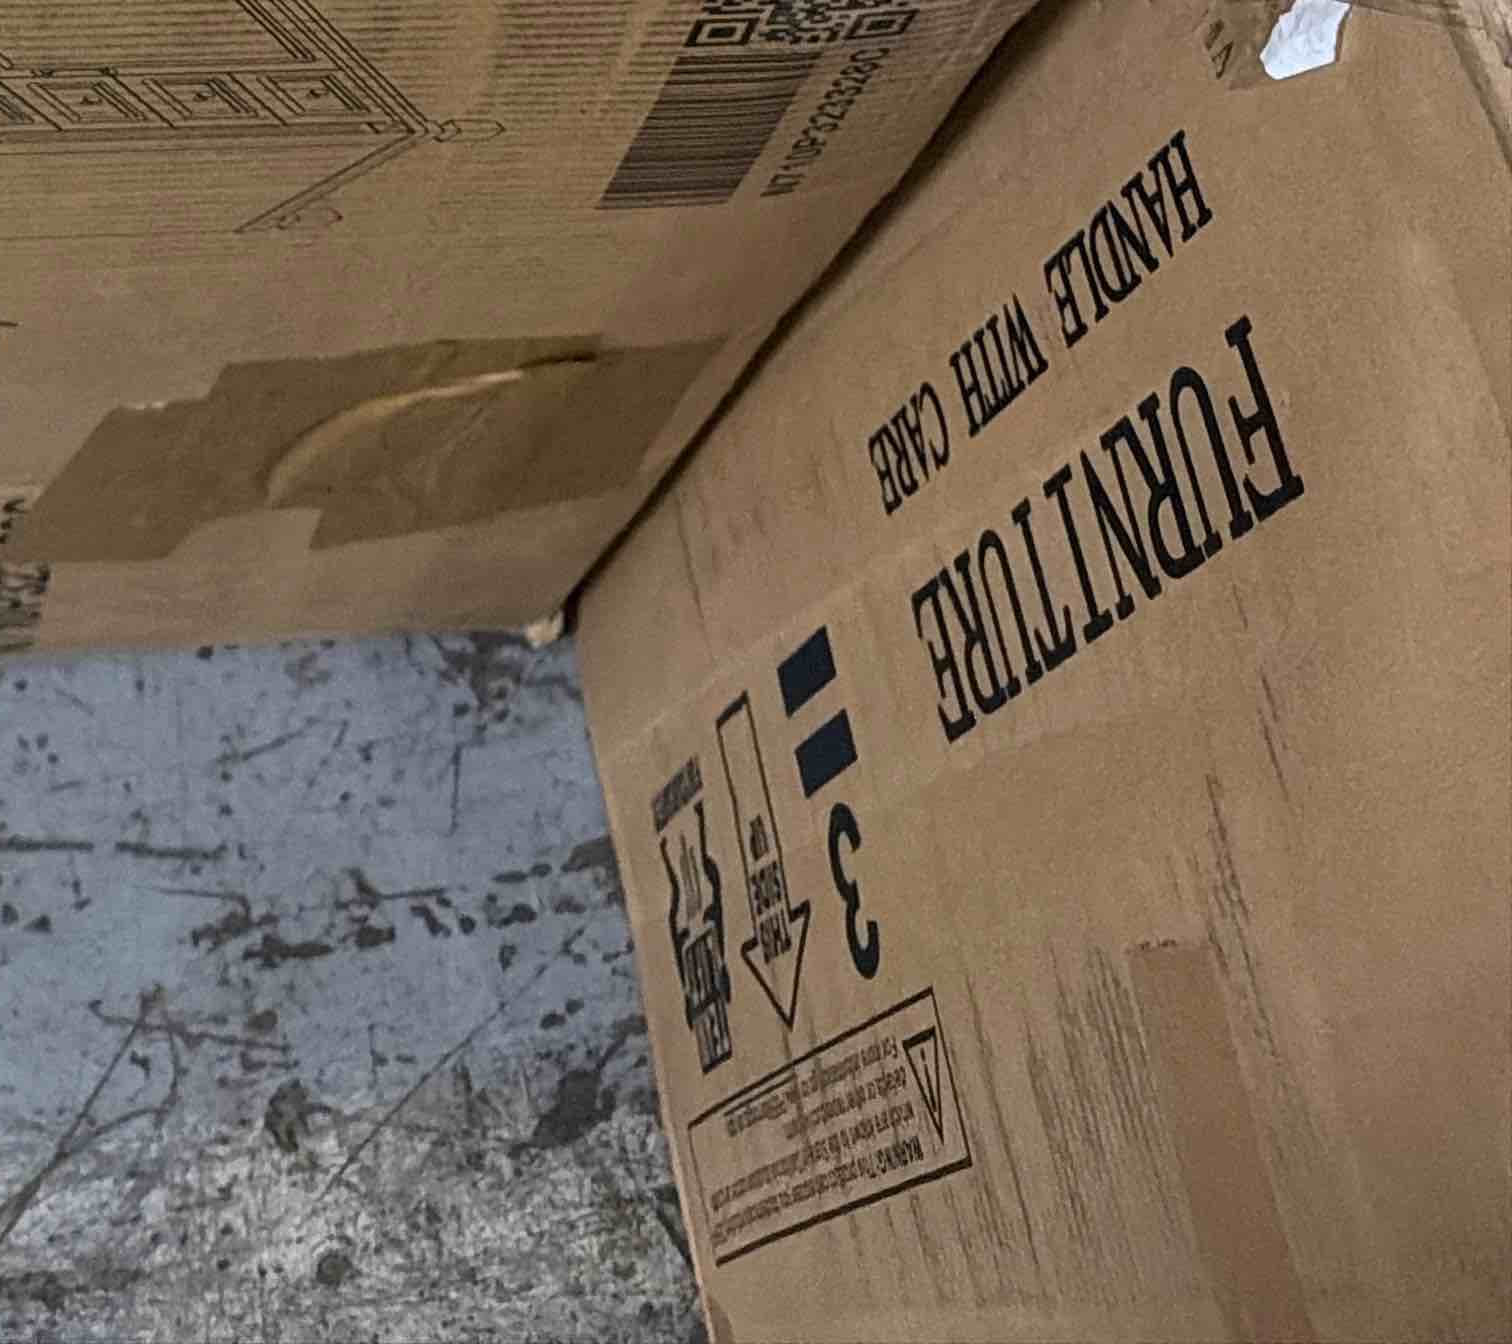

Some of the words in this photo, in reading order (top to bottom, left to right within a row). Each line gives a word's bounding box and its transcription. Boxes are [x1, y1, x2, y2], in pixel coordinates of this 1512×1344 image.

[1043, 128, 1214, 349] HANDLE
[867, 381, 951, 516] CARE
[948, 292, 1050, 439] WITH
[910, 314, 1305, 744] FURNITURE
[828, 802, 881, 980] 3
